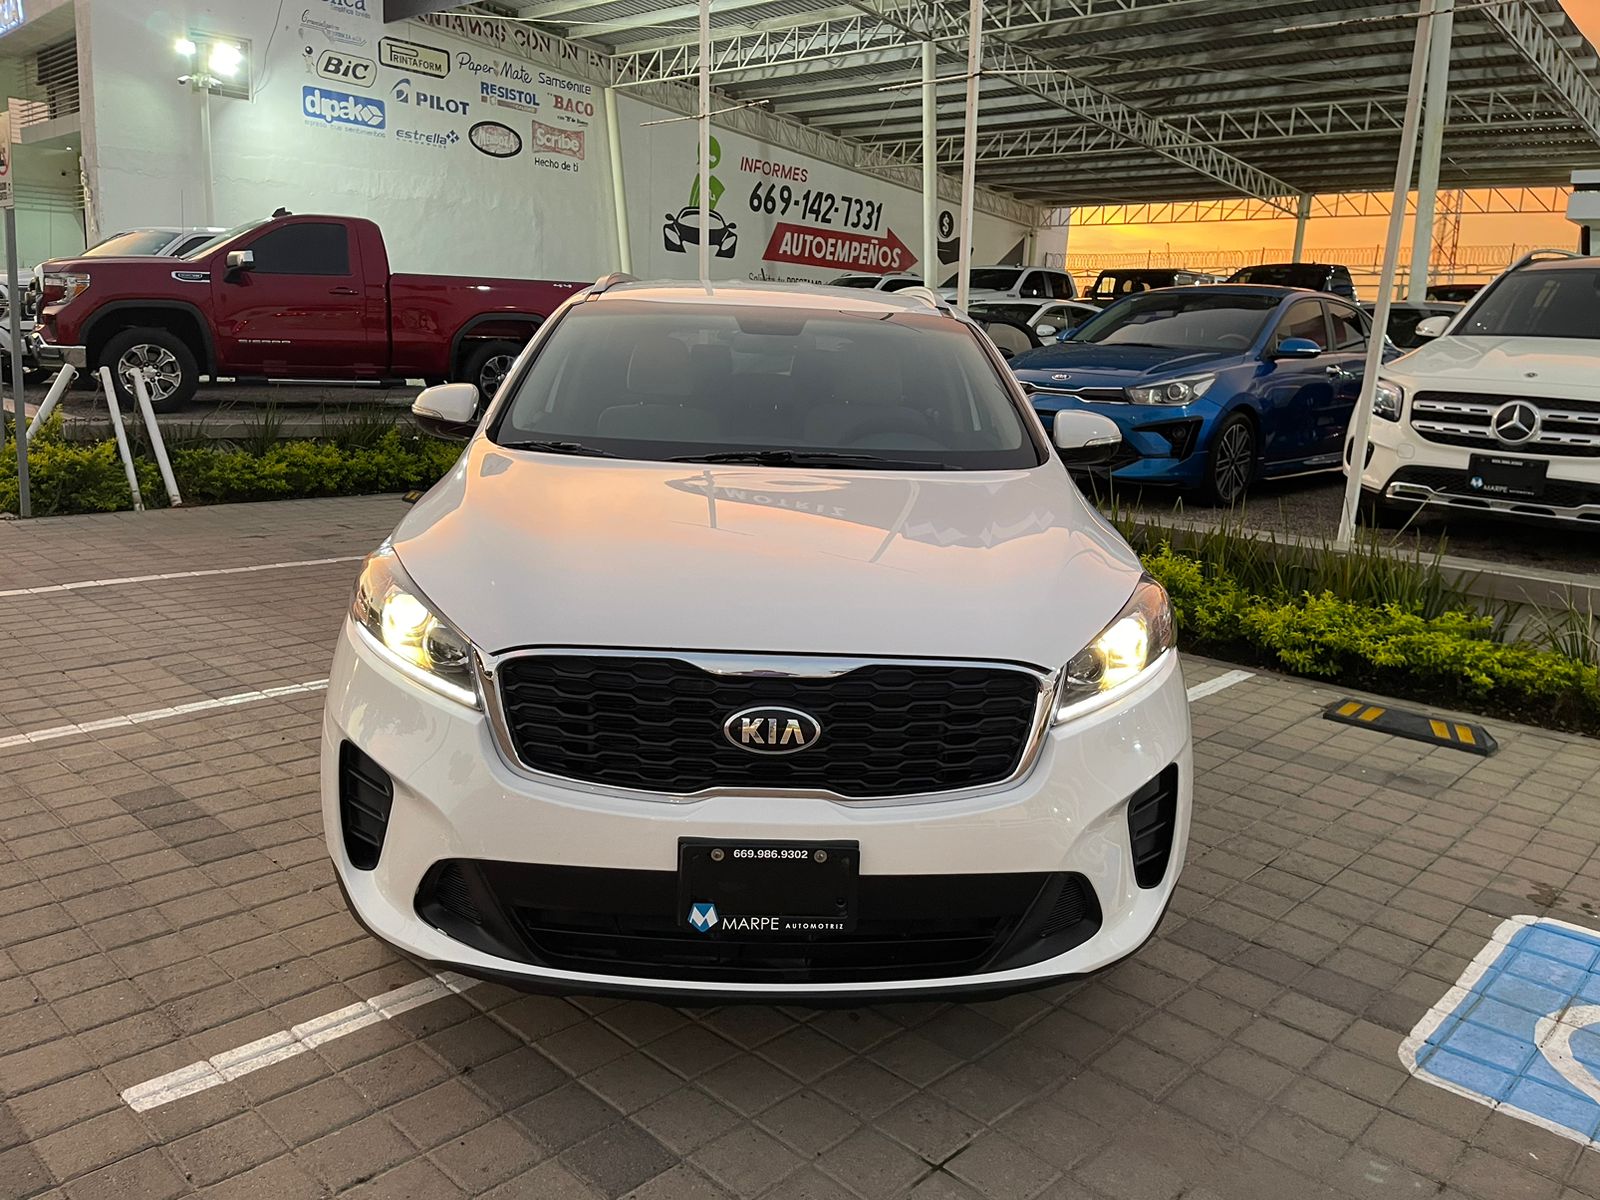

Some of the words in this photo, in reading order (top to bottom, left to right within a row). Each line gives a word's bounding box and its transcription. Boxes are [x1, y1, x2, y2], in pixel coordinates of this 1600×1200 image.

[386, 43, 442, 72] PRINTAFORM
[456, 52, 494, 75] Paper
[500, 62, 533, 84] Mate
[480, 81, 540, 107] RESISTOL
[538, 73, 592, 95] Samsonite
[416, 91, 470, 115] PILOT
[553, 94, 595, 117] BACO
[396, 129, 447, 145] estrella
[535, 127, 580, 154] Scribe
[534, 157, 559, 169] Hecho
[561, 160, 571, 171] de
[573, 161, 579, 172] ti
[740, 156, 809, 183] INFORMES
[779, 231, 901, 268] AUTOEMPEÑOS
[740, 717, 805, 745] KIA
[733, 849, 809, 860] 669.986.9302
[722, 917, 780, 931] MARPE
[785, 922, 844, 931] AUTOMOTRIZ
